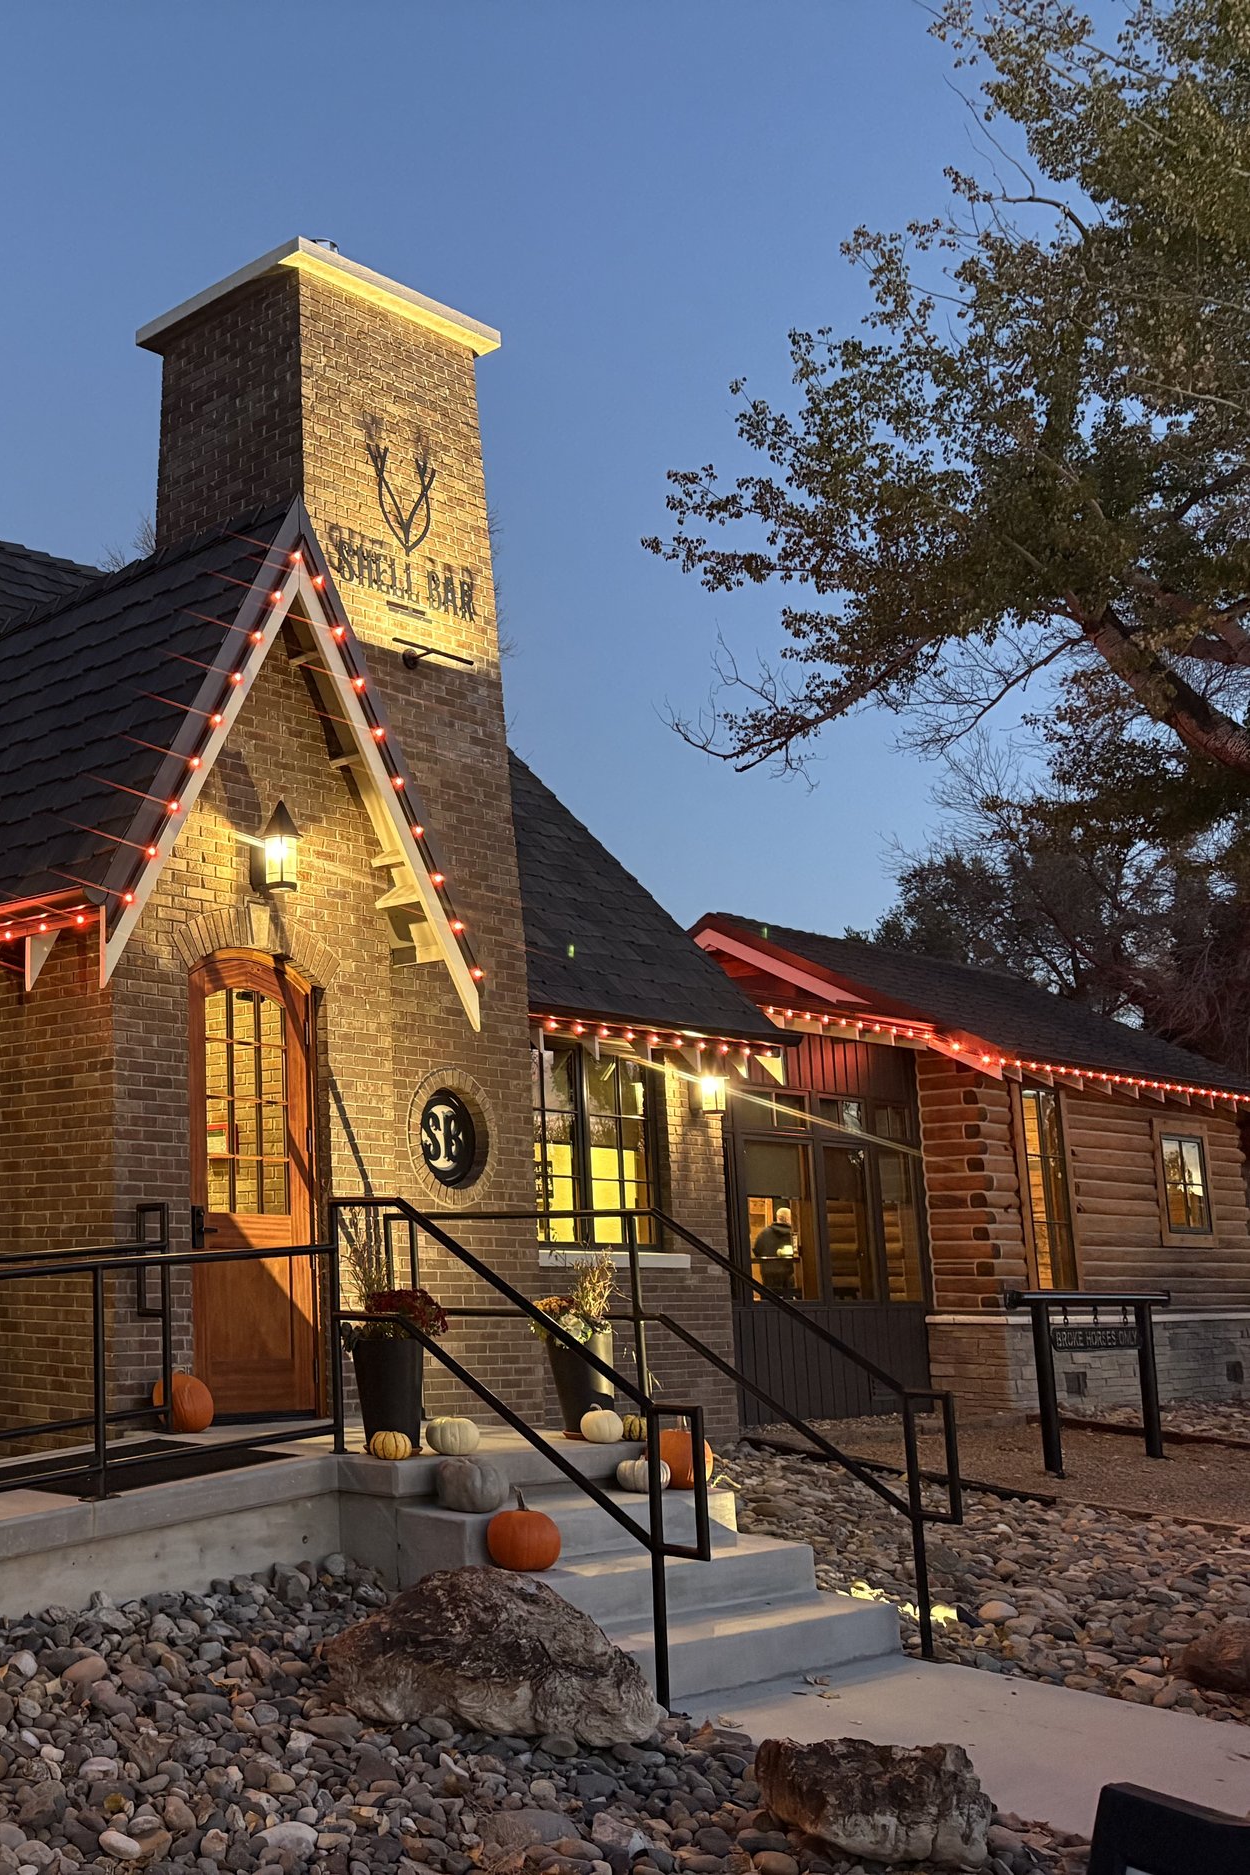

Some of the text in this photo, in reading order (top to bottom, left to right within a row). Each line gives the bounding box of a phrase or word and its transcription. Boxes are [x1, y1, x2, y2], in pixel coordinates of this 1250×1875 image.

[338, 539, 476, 624] SHELL BAR
[422, 1110, 466, 1162] SB
[1055, 1330, 1138, 1348] BROKE HORSES ONLY
